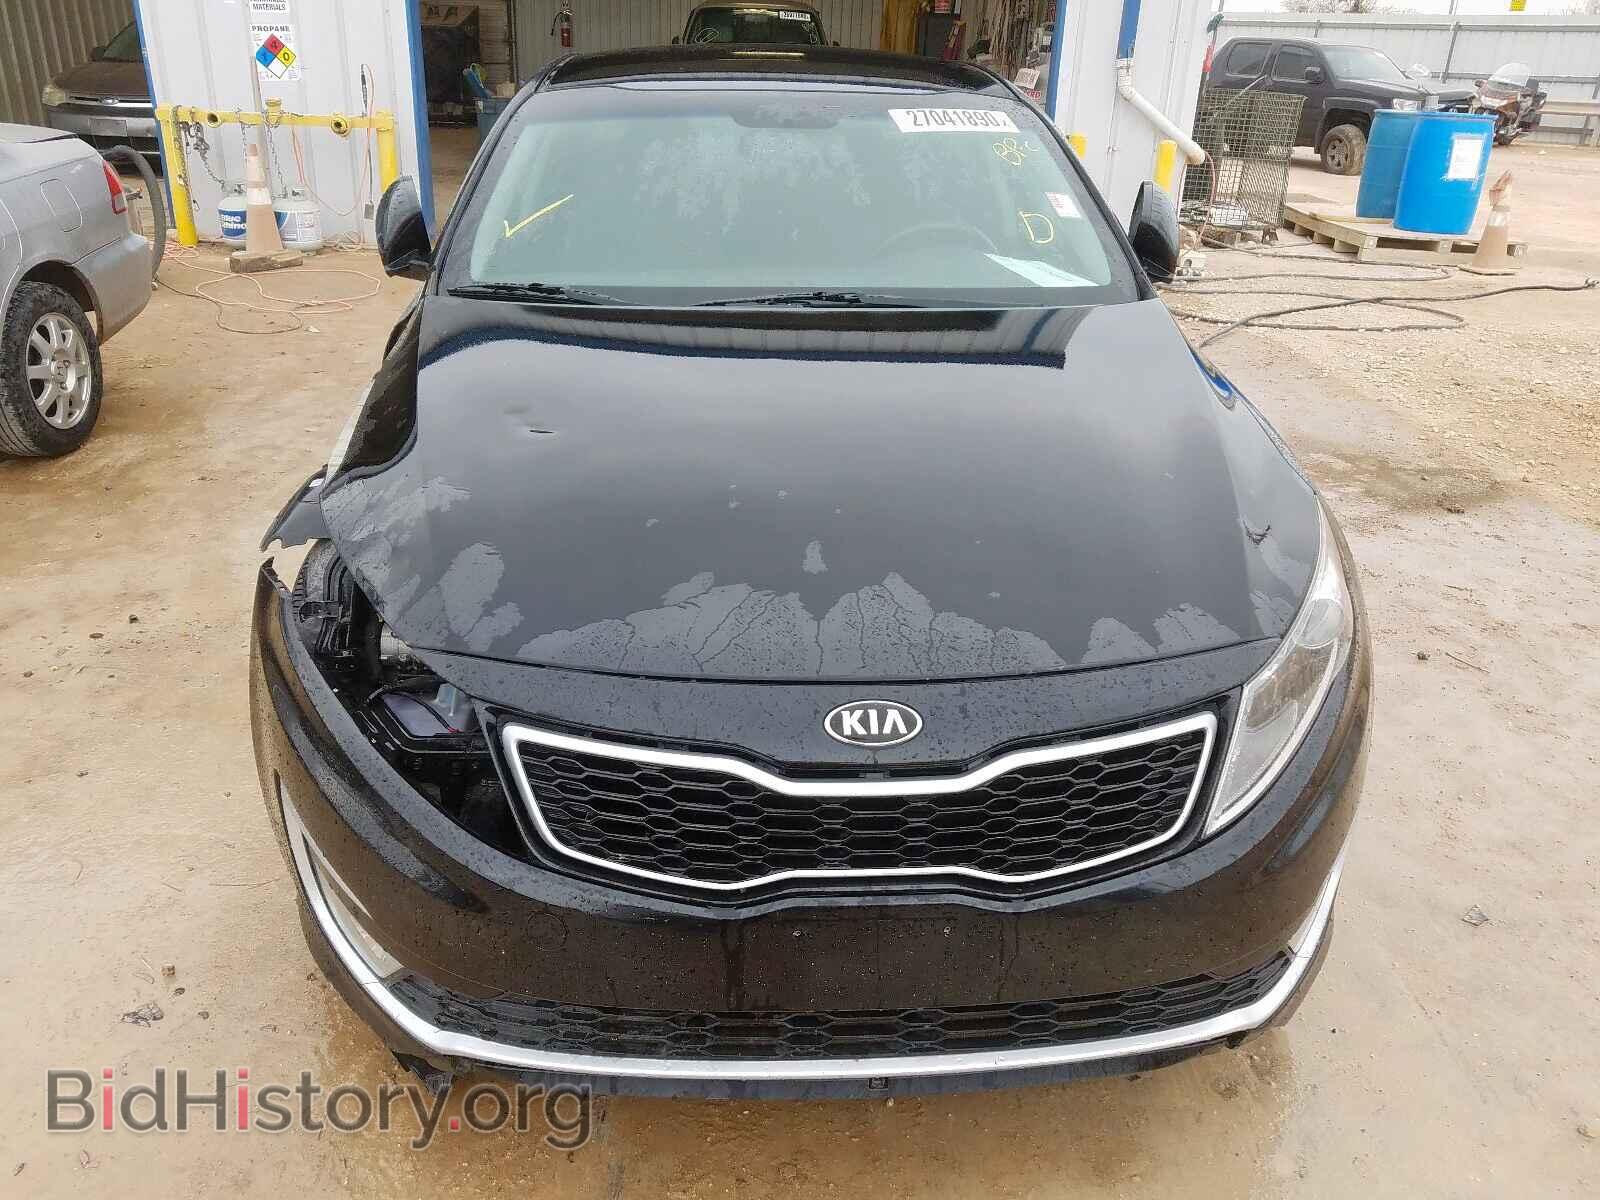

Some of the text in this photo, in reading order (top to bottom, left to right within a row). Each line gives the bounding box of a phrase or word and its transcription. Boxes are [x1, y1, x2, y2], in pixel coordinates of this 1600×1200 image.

[252, 3, 286, 11] MATERIALS
[271, 41, 278, 50] 4
[282, 52, 290, 62] 0
[840, 708, 908, 736] KIA
